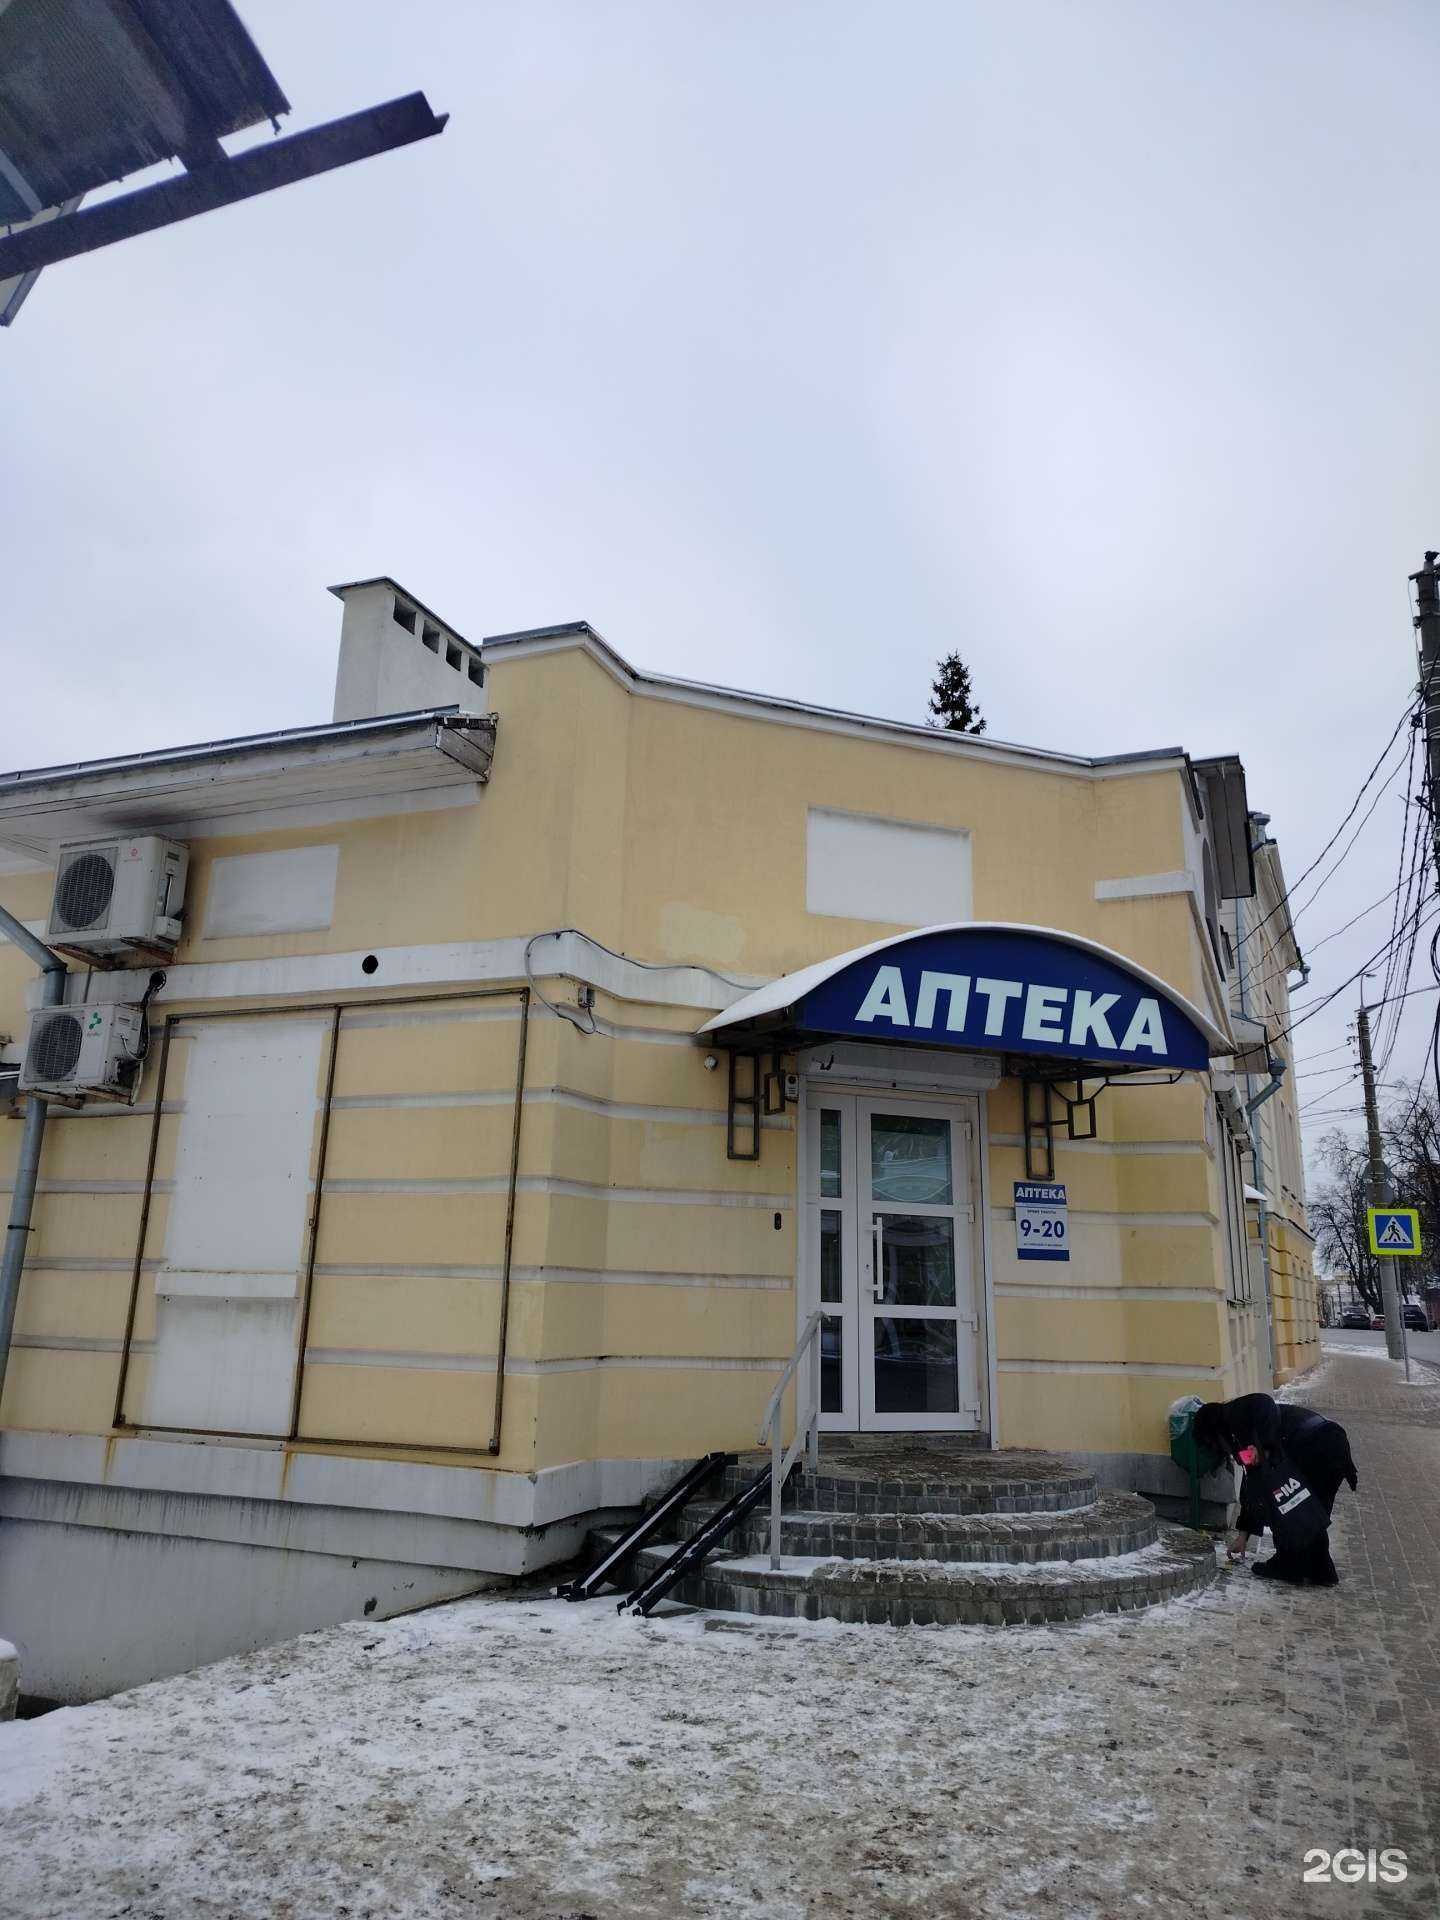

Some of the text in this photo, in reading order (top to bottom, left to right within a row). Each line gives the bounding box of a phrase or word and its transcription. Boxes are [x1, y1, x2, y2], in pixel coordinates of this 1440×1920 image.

[854, 965, 1168, 1055] АПТЕКА
[1016, 1187, 1066, 1200] АПТЕКА
[1020, 1219, 1065, 1238] 9-20
[1273, 1478, 1301, 1502] FILA
